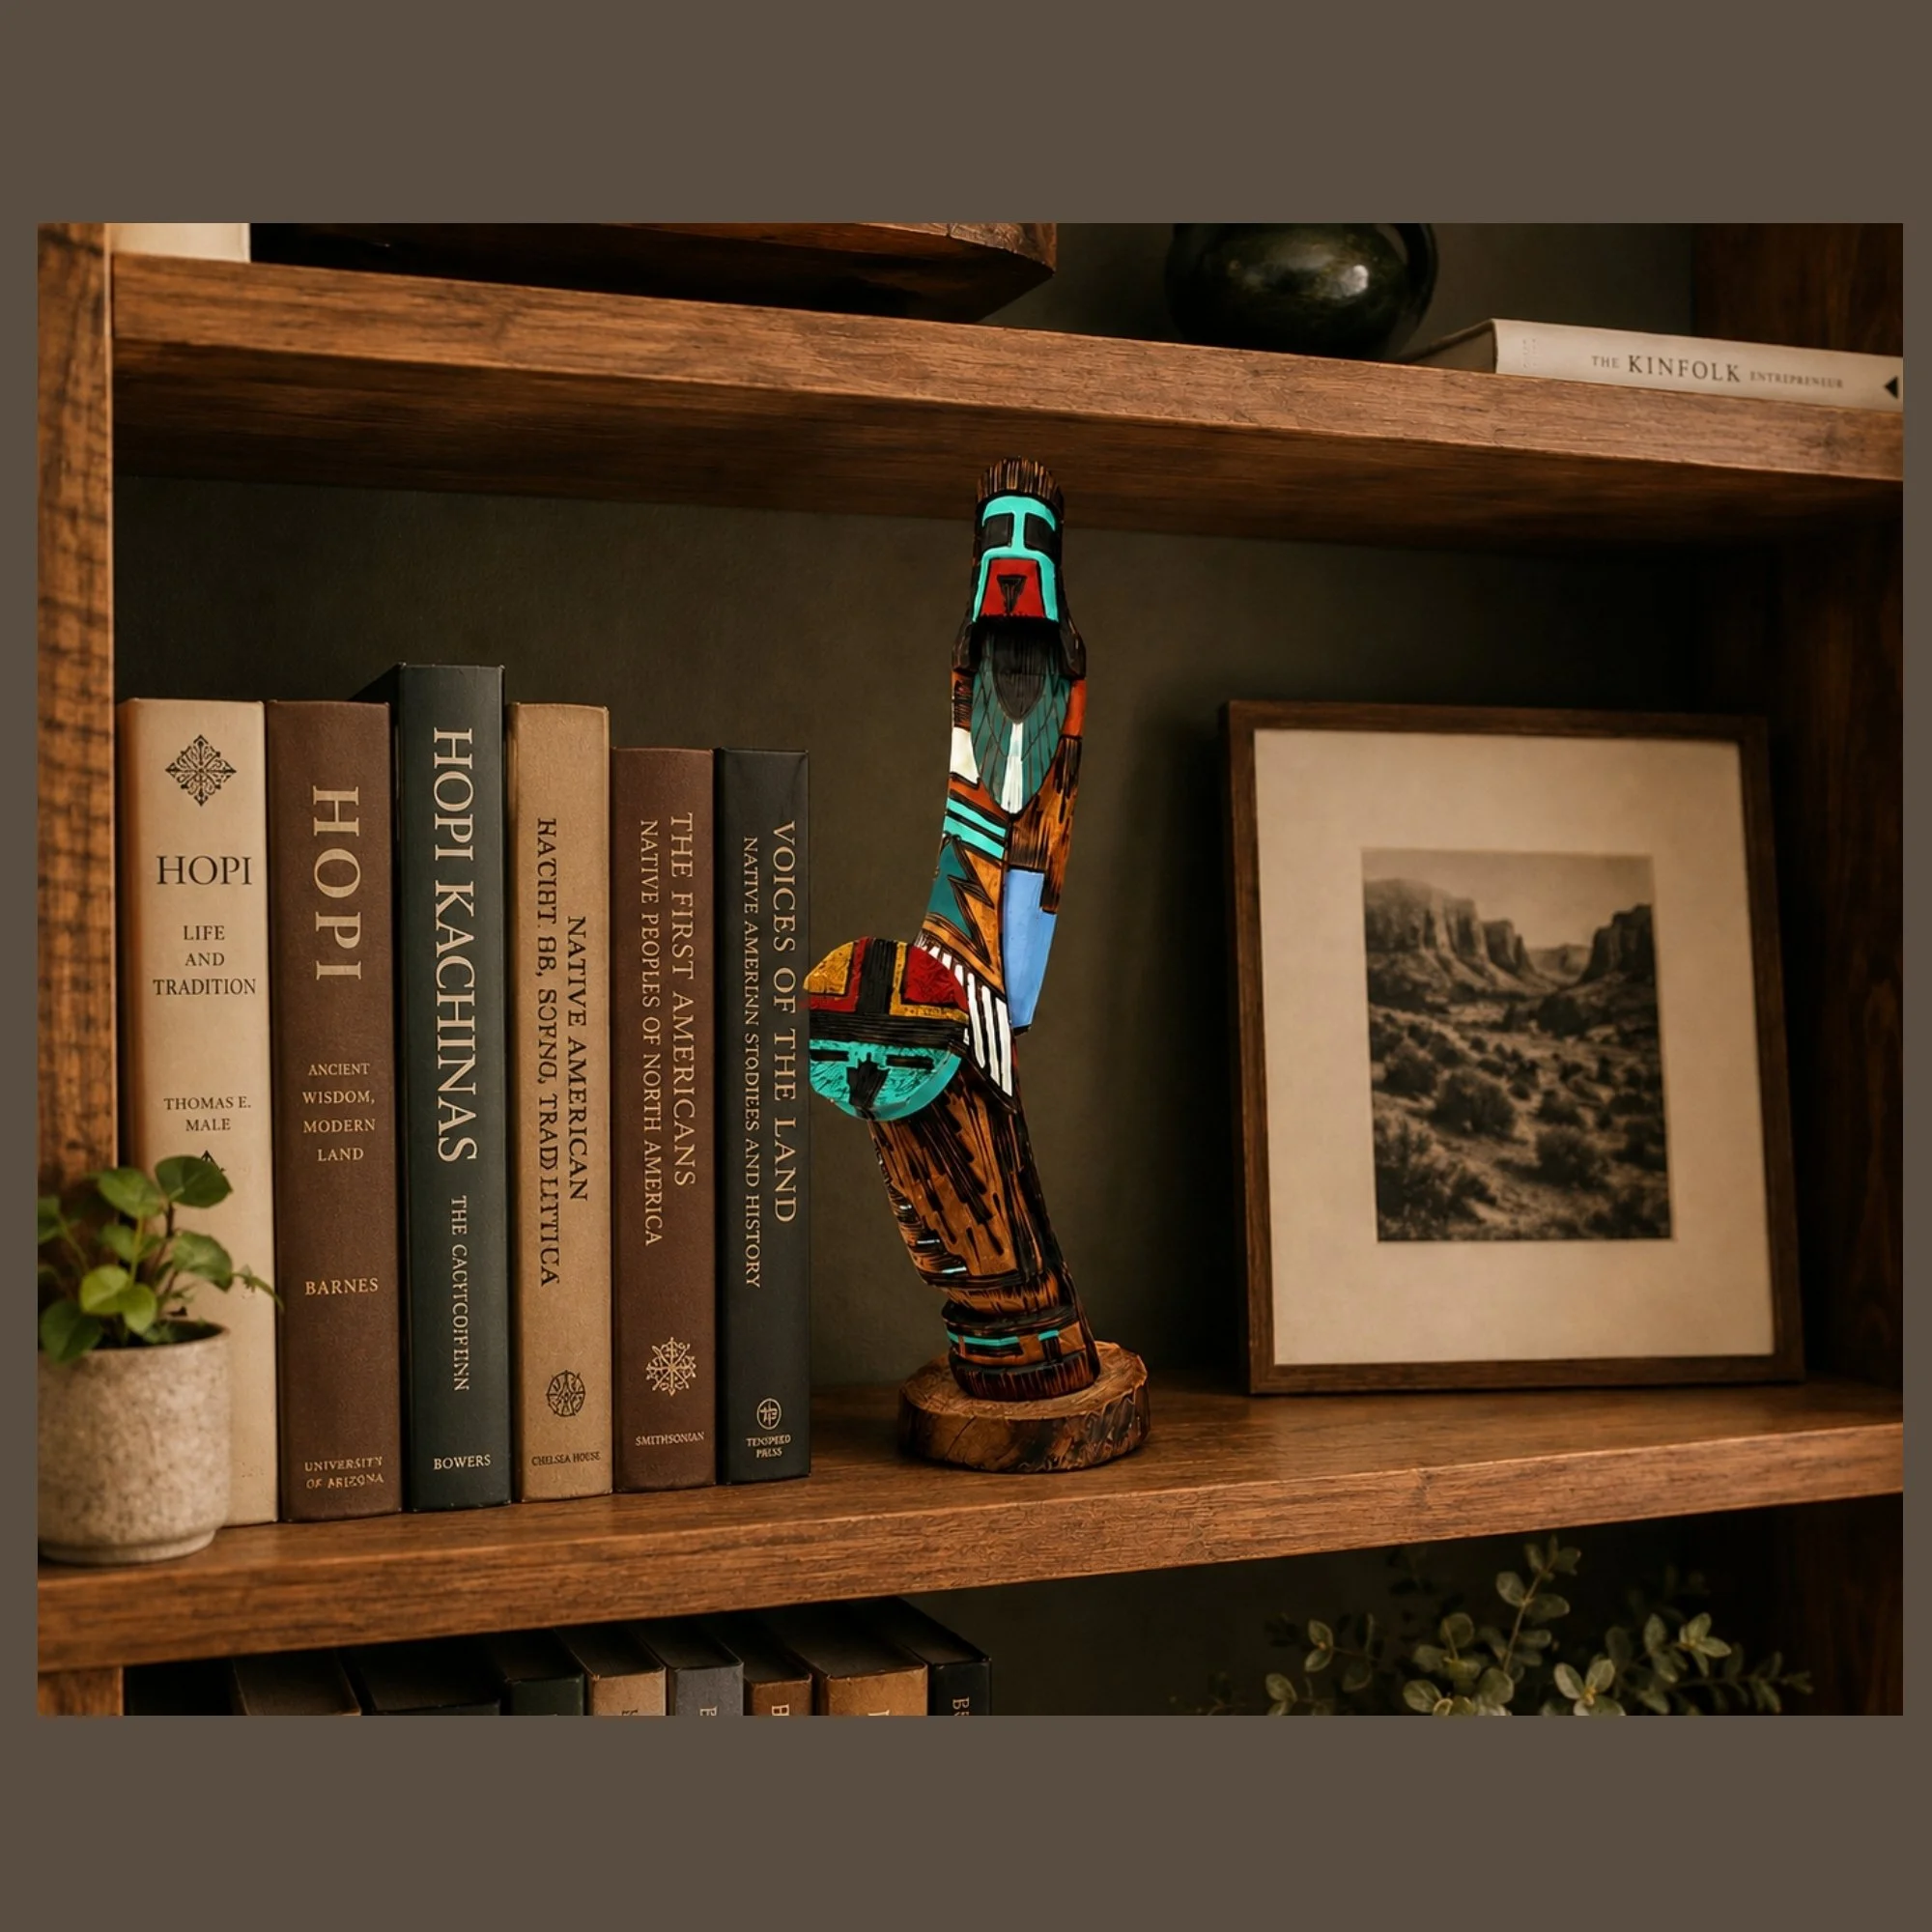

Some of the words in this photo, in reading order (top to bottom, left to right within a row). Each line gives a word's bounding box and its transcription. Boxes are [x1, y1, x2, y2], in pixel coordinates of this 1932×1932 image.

[1591, 355, 1620, 369] THE
[1628, 355, 1741, 384] KINFOLK
[1749, 371, 1844, 389] ENTREPRENEUR
[433, 726, 474, 862] HOPI
[640, 819, 660, 904] NATIVE
[670, 811, 694, 877] THE
[156, 855, 251, 885] HOPI
[312, 785, 362, 980] HOPI
[743, 837, 758, 914] NATIVE
[773, 820, 796, 952] VOICES
[183, 924, 225, 941] LIFE
[671, 891, 695, 980] FIRST
[185, 952, 225, 967] AND
[567, 916, 587, 1027] NATIVE
[640, 913, 661, 1008] PEOPLES
[152, 978, 256, 996] TRADITION
[773, 967, 796, 1014] OF
[435, 879, 478, 1162] KACHINAS
[641, 1016, 661, 1046] OF
[308, 1063, 371, 1076] ANCIENT
[774, 1028, 796, 1101] THE
[162, 1096, 234, 1111] THOMAS
[238, 1095, 251, 1109] E.
[302, 1090, 376, 1105] WISDOM,
[642, 1053, 661, 1133] NORTH
[672, 991, 696, 1186] AMERICANS
[185, 1118, 231, 1132] MALE
[303, 1118, 376, 1133] MODERN
[567, 1036, 588, 1202] AMERICAN
[318, 1147, 364, 1162] LAND
[745, 1138, 760, 1187] AND
[774, 1118, 797, 1222] LAND
[451, 1195, 468, 1236] THE
[643, 1138, 662, 1246] AMERICA
[745, 1194, 761, 1288] HISTORY
[305, 1277, 379, 1295] BARNES
[434, 1454, 492, 1470] BOWERS
[635, 1431, 705, 1447] SMITHSONIAN
[304, 1456, 384, 1472] UNIVERSITY
[305, 1478, 323, 1490] OF
